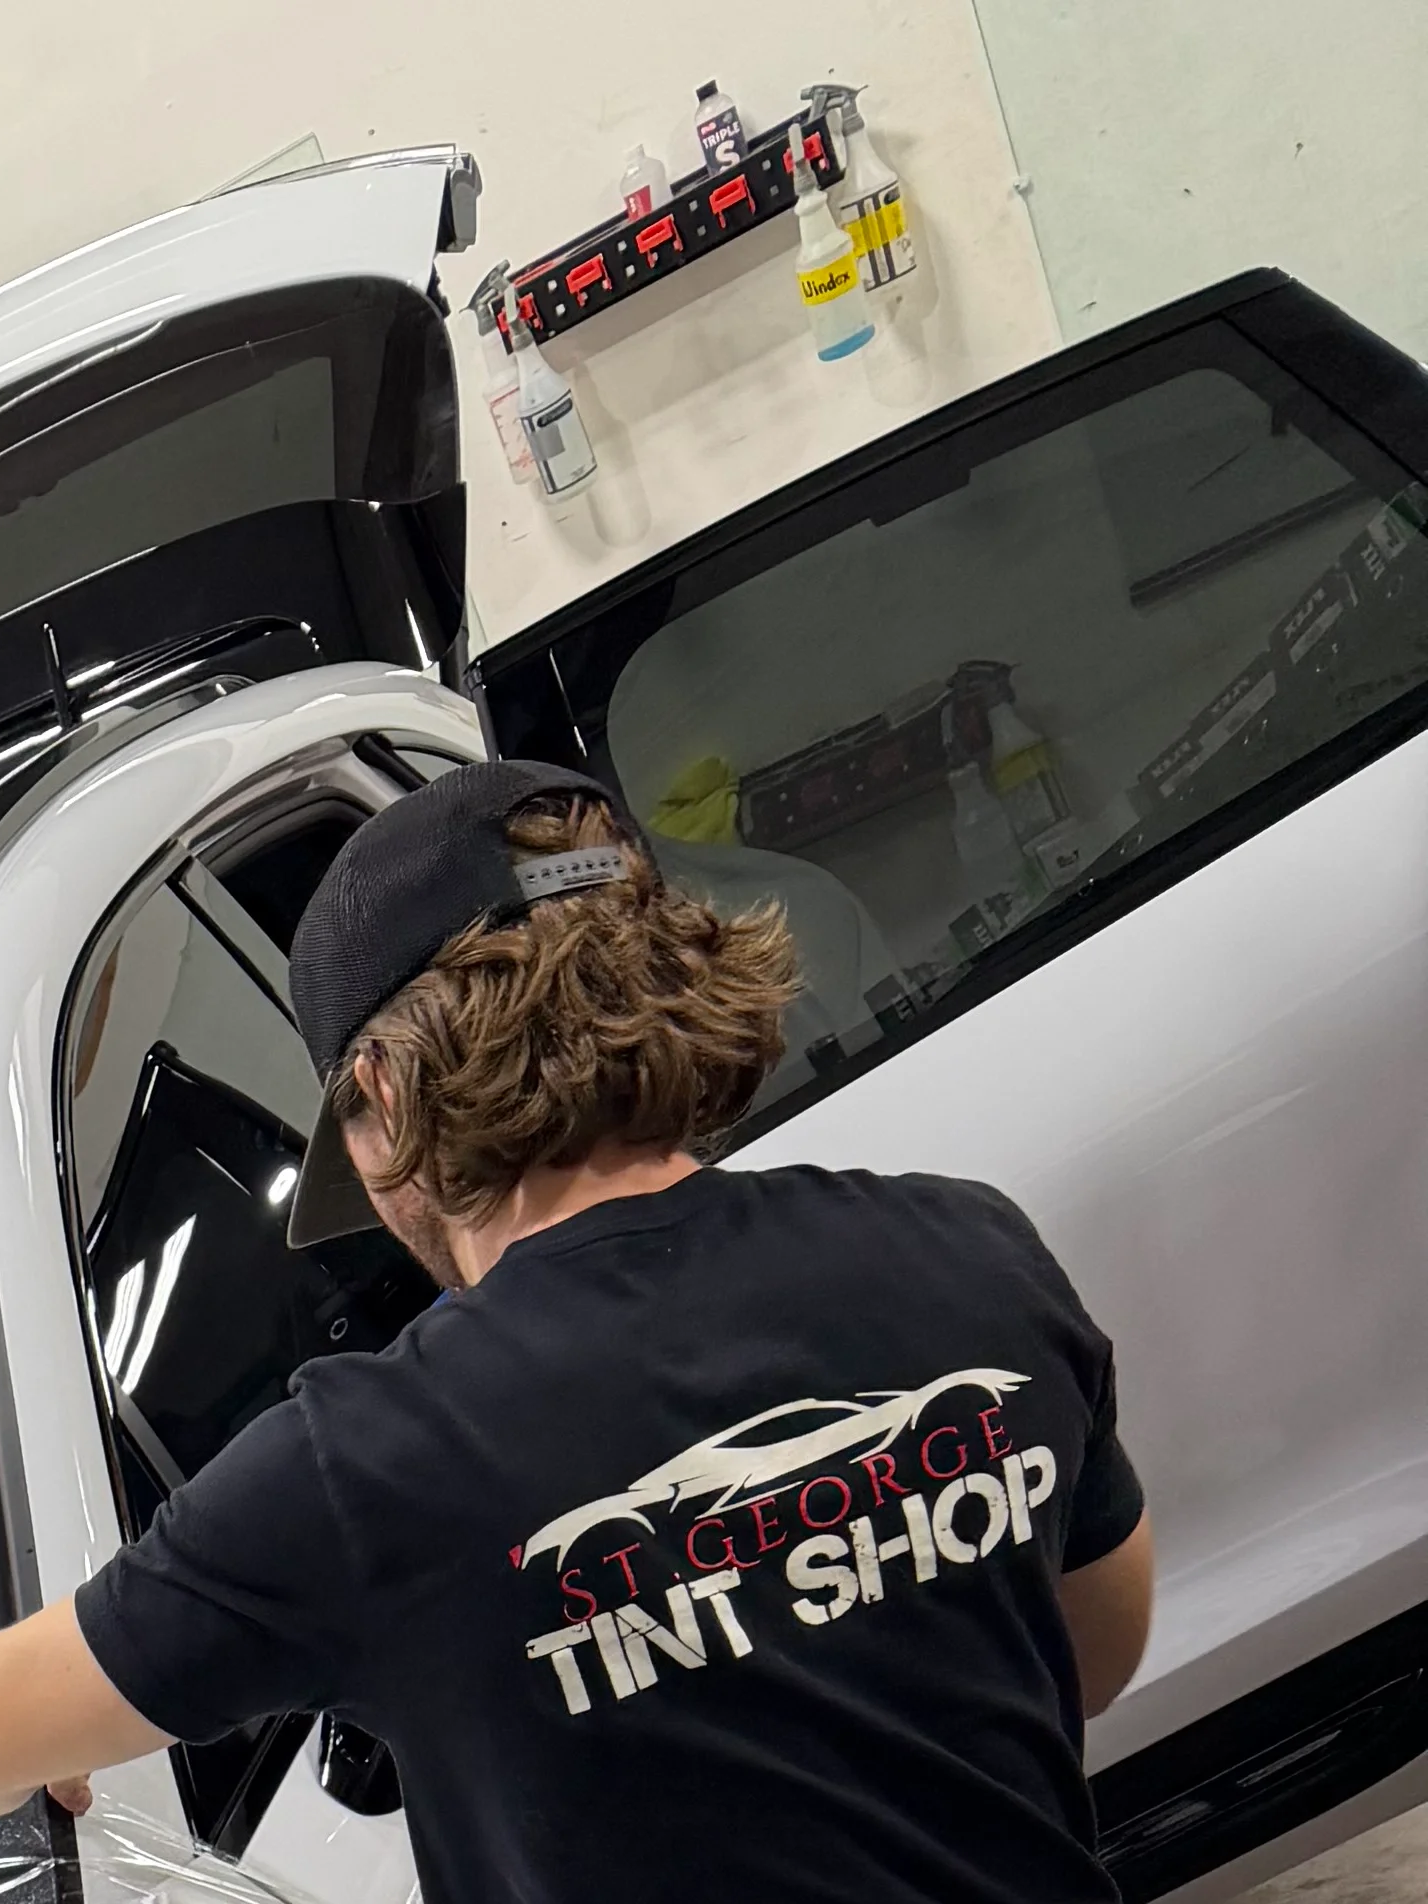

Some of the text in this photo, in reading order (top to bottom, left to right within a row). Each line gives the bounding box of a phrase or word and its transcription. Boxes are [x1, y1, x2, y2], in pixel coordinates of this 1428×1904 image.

[702, 121, 741, 150] TRIPLE
[715, 139, 741, 174] S
[685, 1405, 1014, 1572] GEORGE
[525, 1444, 1057, 1716] TINT SHOP
